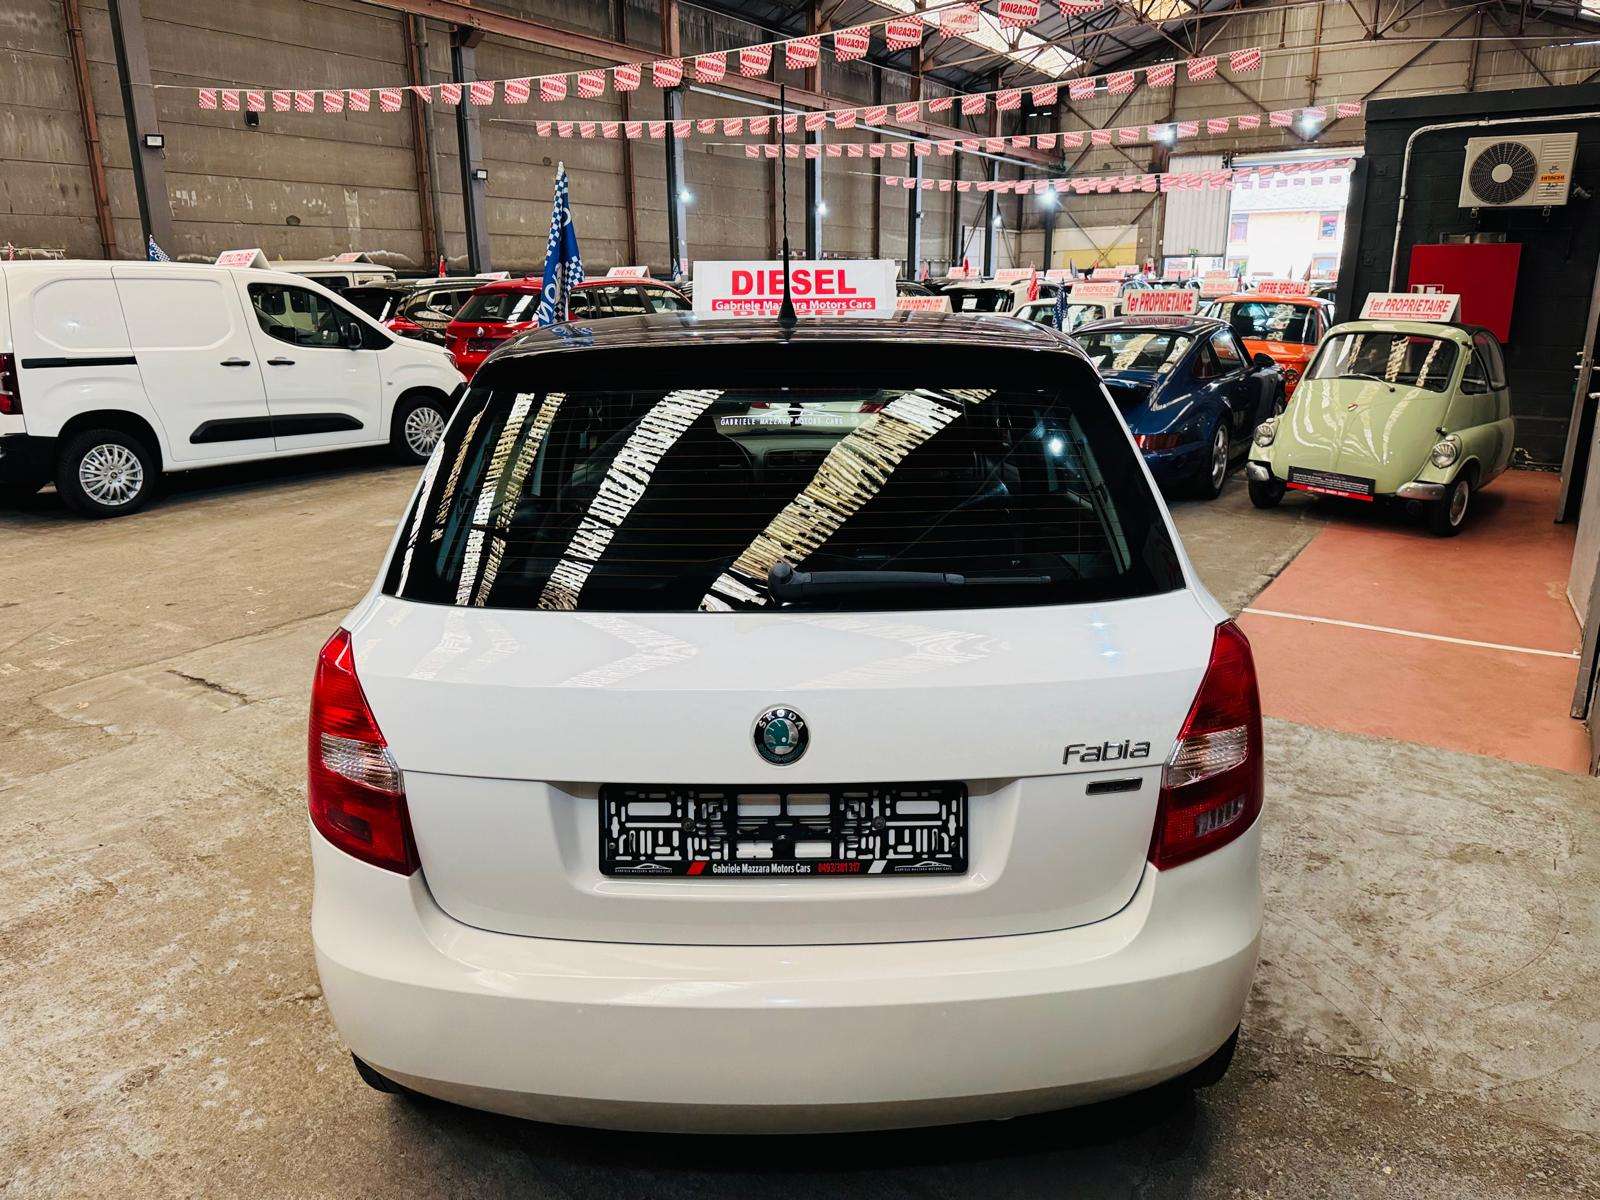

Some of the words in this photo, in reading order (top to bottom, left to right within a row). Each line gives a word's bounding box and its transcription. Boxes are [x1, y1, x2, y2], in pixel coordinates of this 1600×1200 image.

[731, 269, 857, 295] DIESEL
[1258, 283, 1278, 294] OFFRE
[1279, 283, 1306, 295] SPECIALE
[715, 300, 761, 311] Gabriele
[809, 299, 847, 310] Motors
[850, 298, 872, 309] Cars
[1127, 292, 1138, 311] 1er
[1139, 292, 1194, 312] PROPRIETAIRE
[1369, 299, 1383, 311] 1er
[1384, 299, 1451, 313] PROPRIETAIRE
[1062, 740, 1151, 765] Fabia
[712, 863, 740, 873] Gabriele
[741, 863, 770, 873] Mazzara
[771, 863, 794, 873] Motors
[795, 863, 811, 873] Cars
